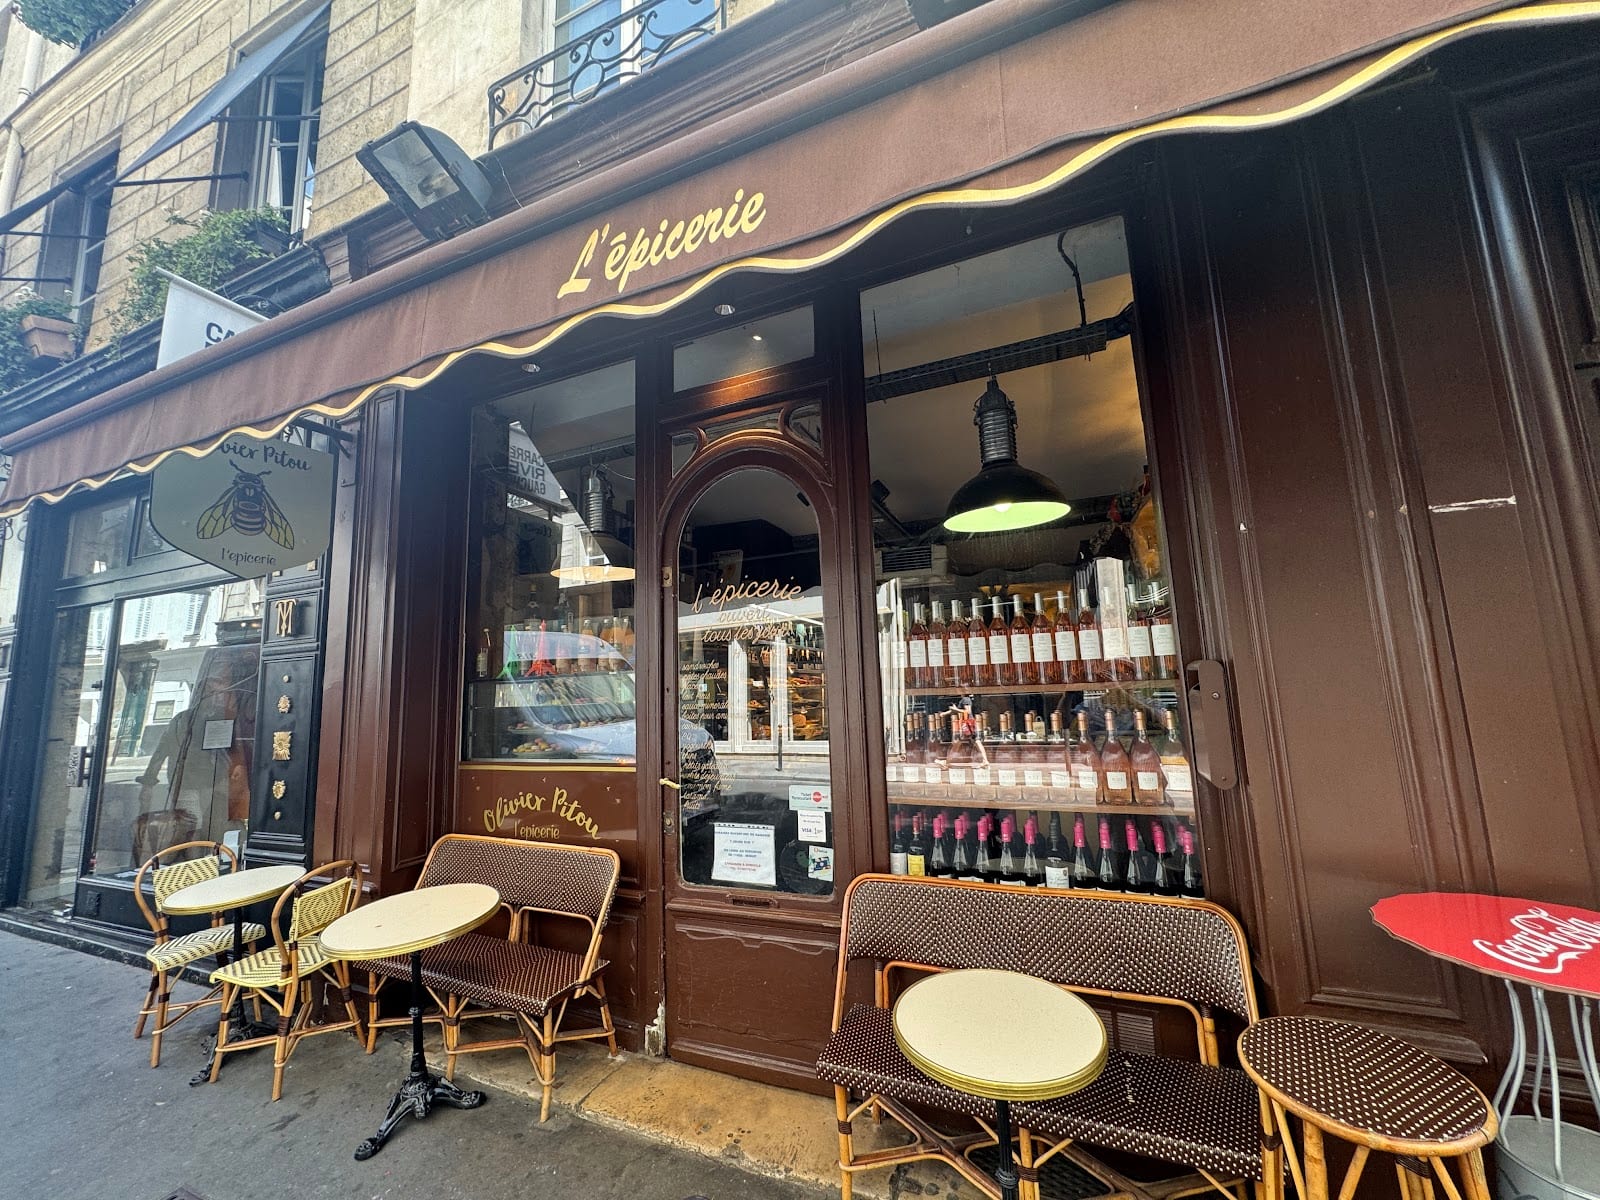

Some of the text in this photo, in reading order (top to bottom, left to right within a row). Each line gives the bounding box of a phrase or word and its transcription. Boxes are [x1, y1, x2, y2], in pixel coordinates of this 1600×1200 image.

[263, 444, 312, 471] Pitou
[701, 625, 732, 643] tous
[483, 786, 601, 840] Olivier Pitou
